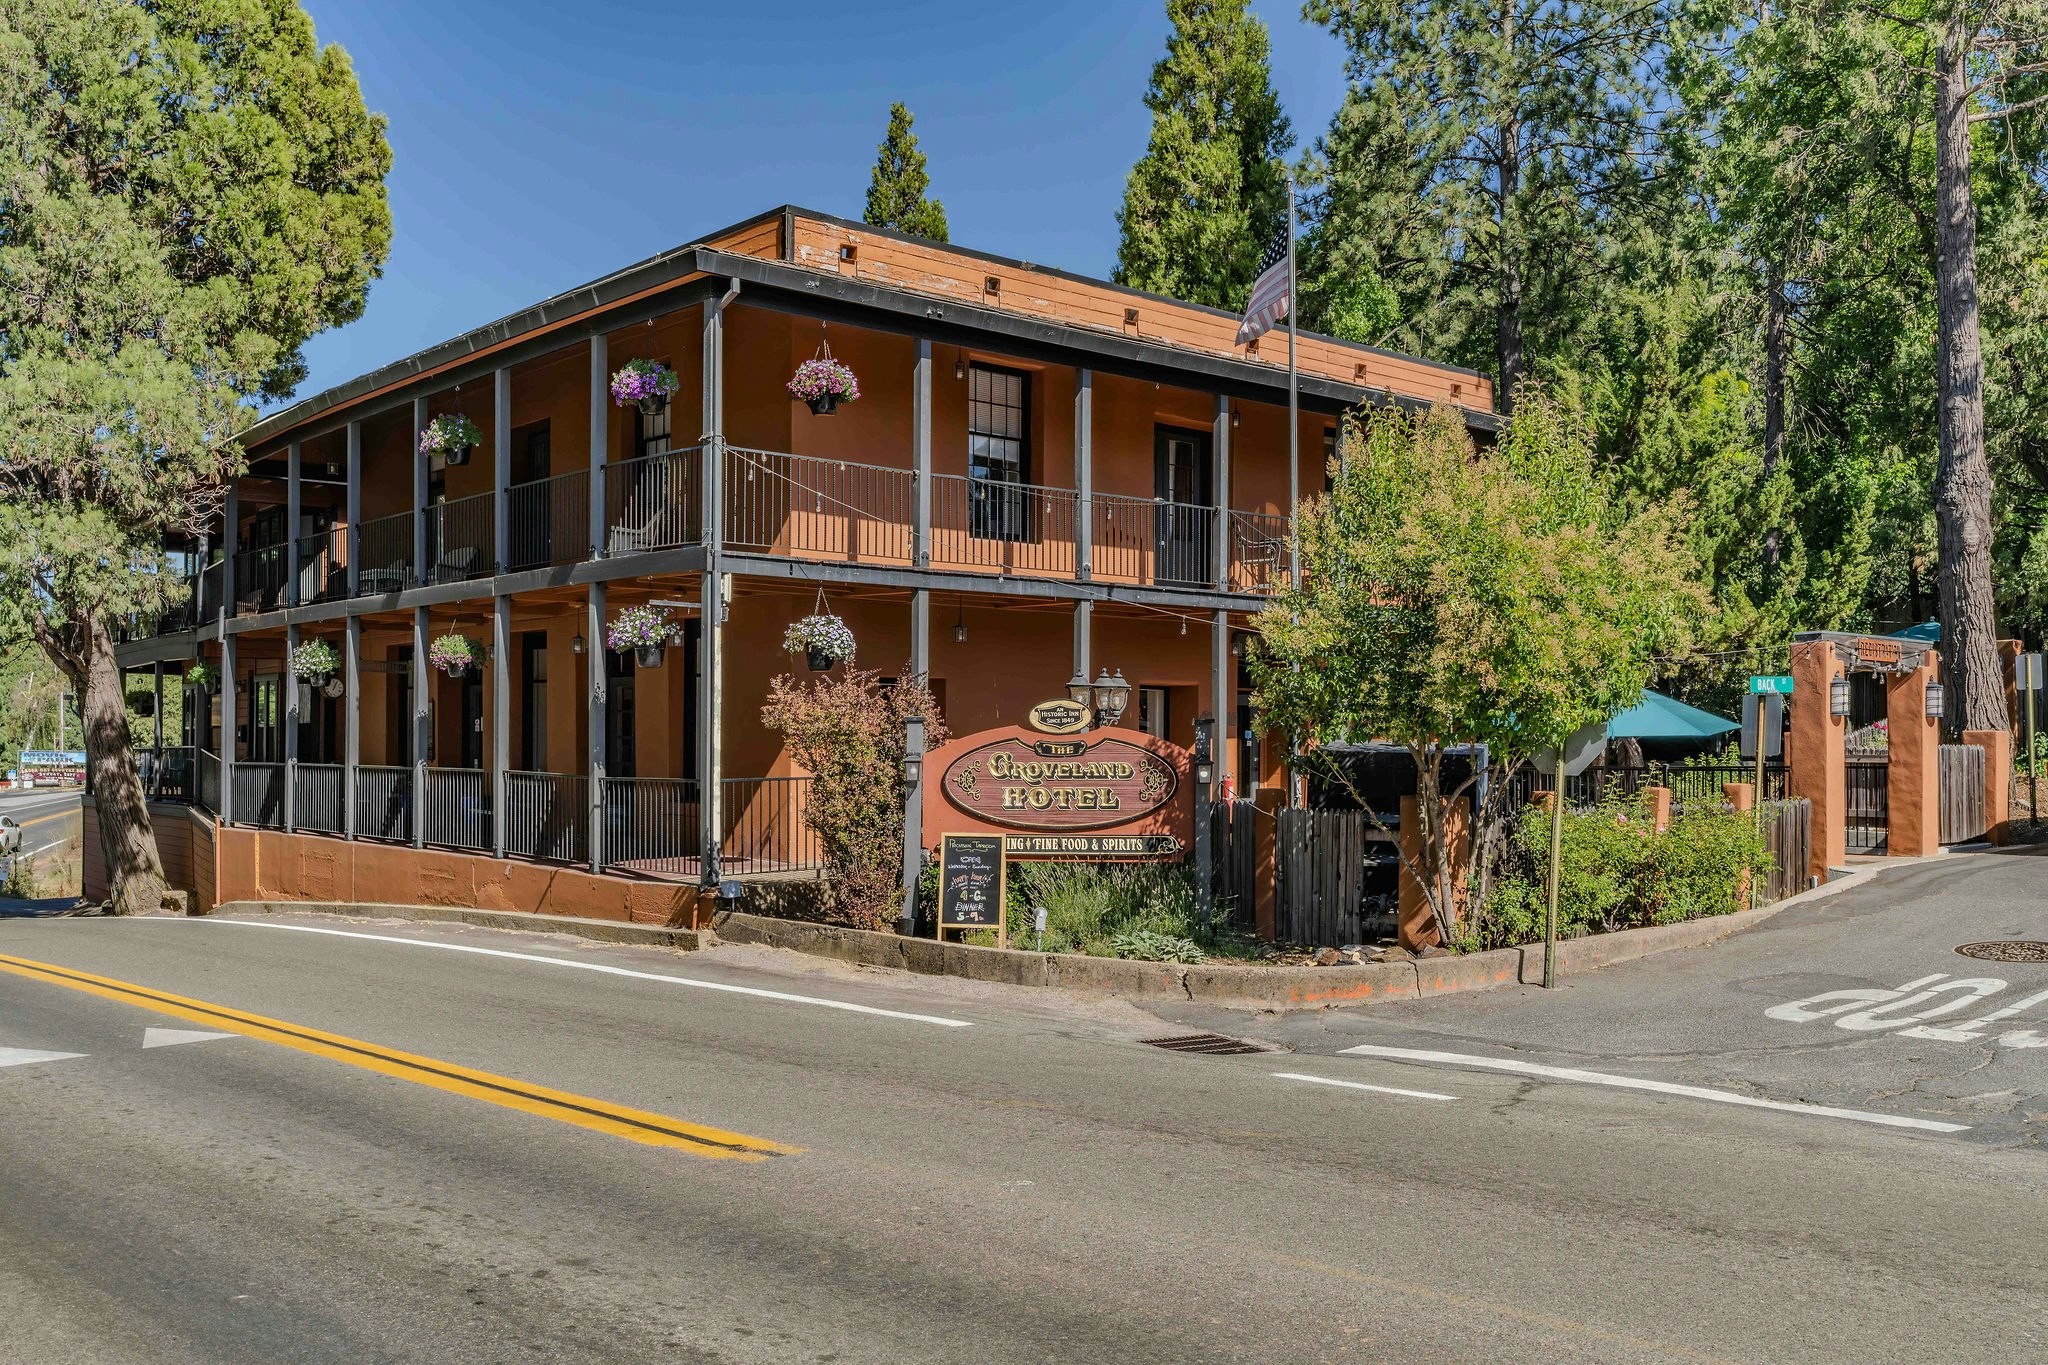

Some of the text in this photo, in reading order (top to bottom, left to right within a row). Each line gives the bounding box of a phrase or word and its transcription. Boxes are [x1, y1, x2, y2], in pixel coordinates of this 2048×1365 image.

[1757, 678, 1776, 691] BACK
[1043, 743, 1075, 755] THE
[987, 752, 1135, 786] GROVELAND
[1001, 786, 1121, 811] HOTEL
[1033, 837, 1058, 850] FINE
[1062, 838, 1088, 850] FOOD
[1091, 838, 1099, 850] &
[1102, 838, 1143, 851] SPIRITS
[955, 901, 985, 911] DINNER
